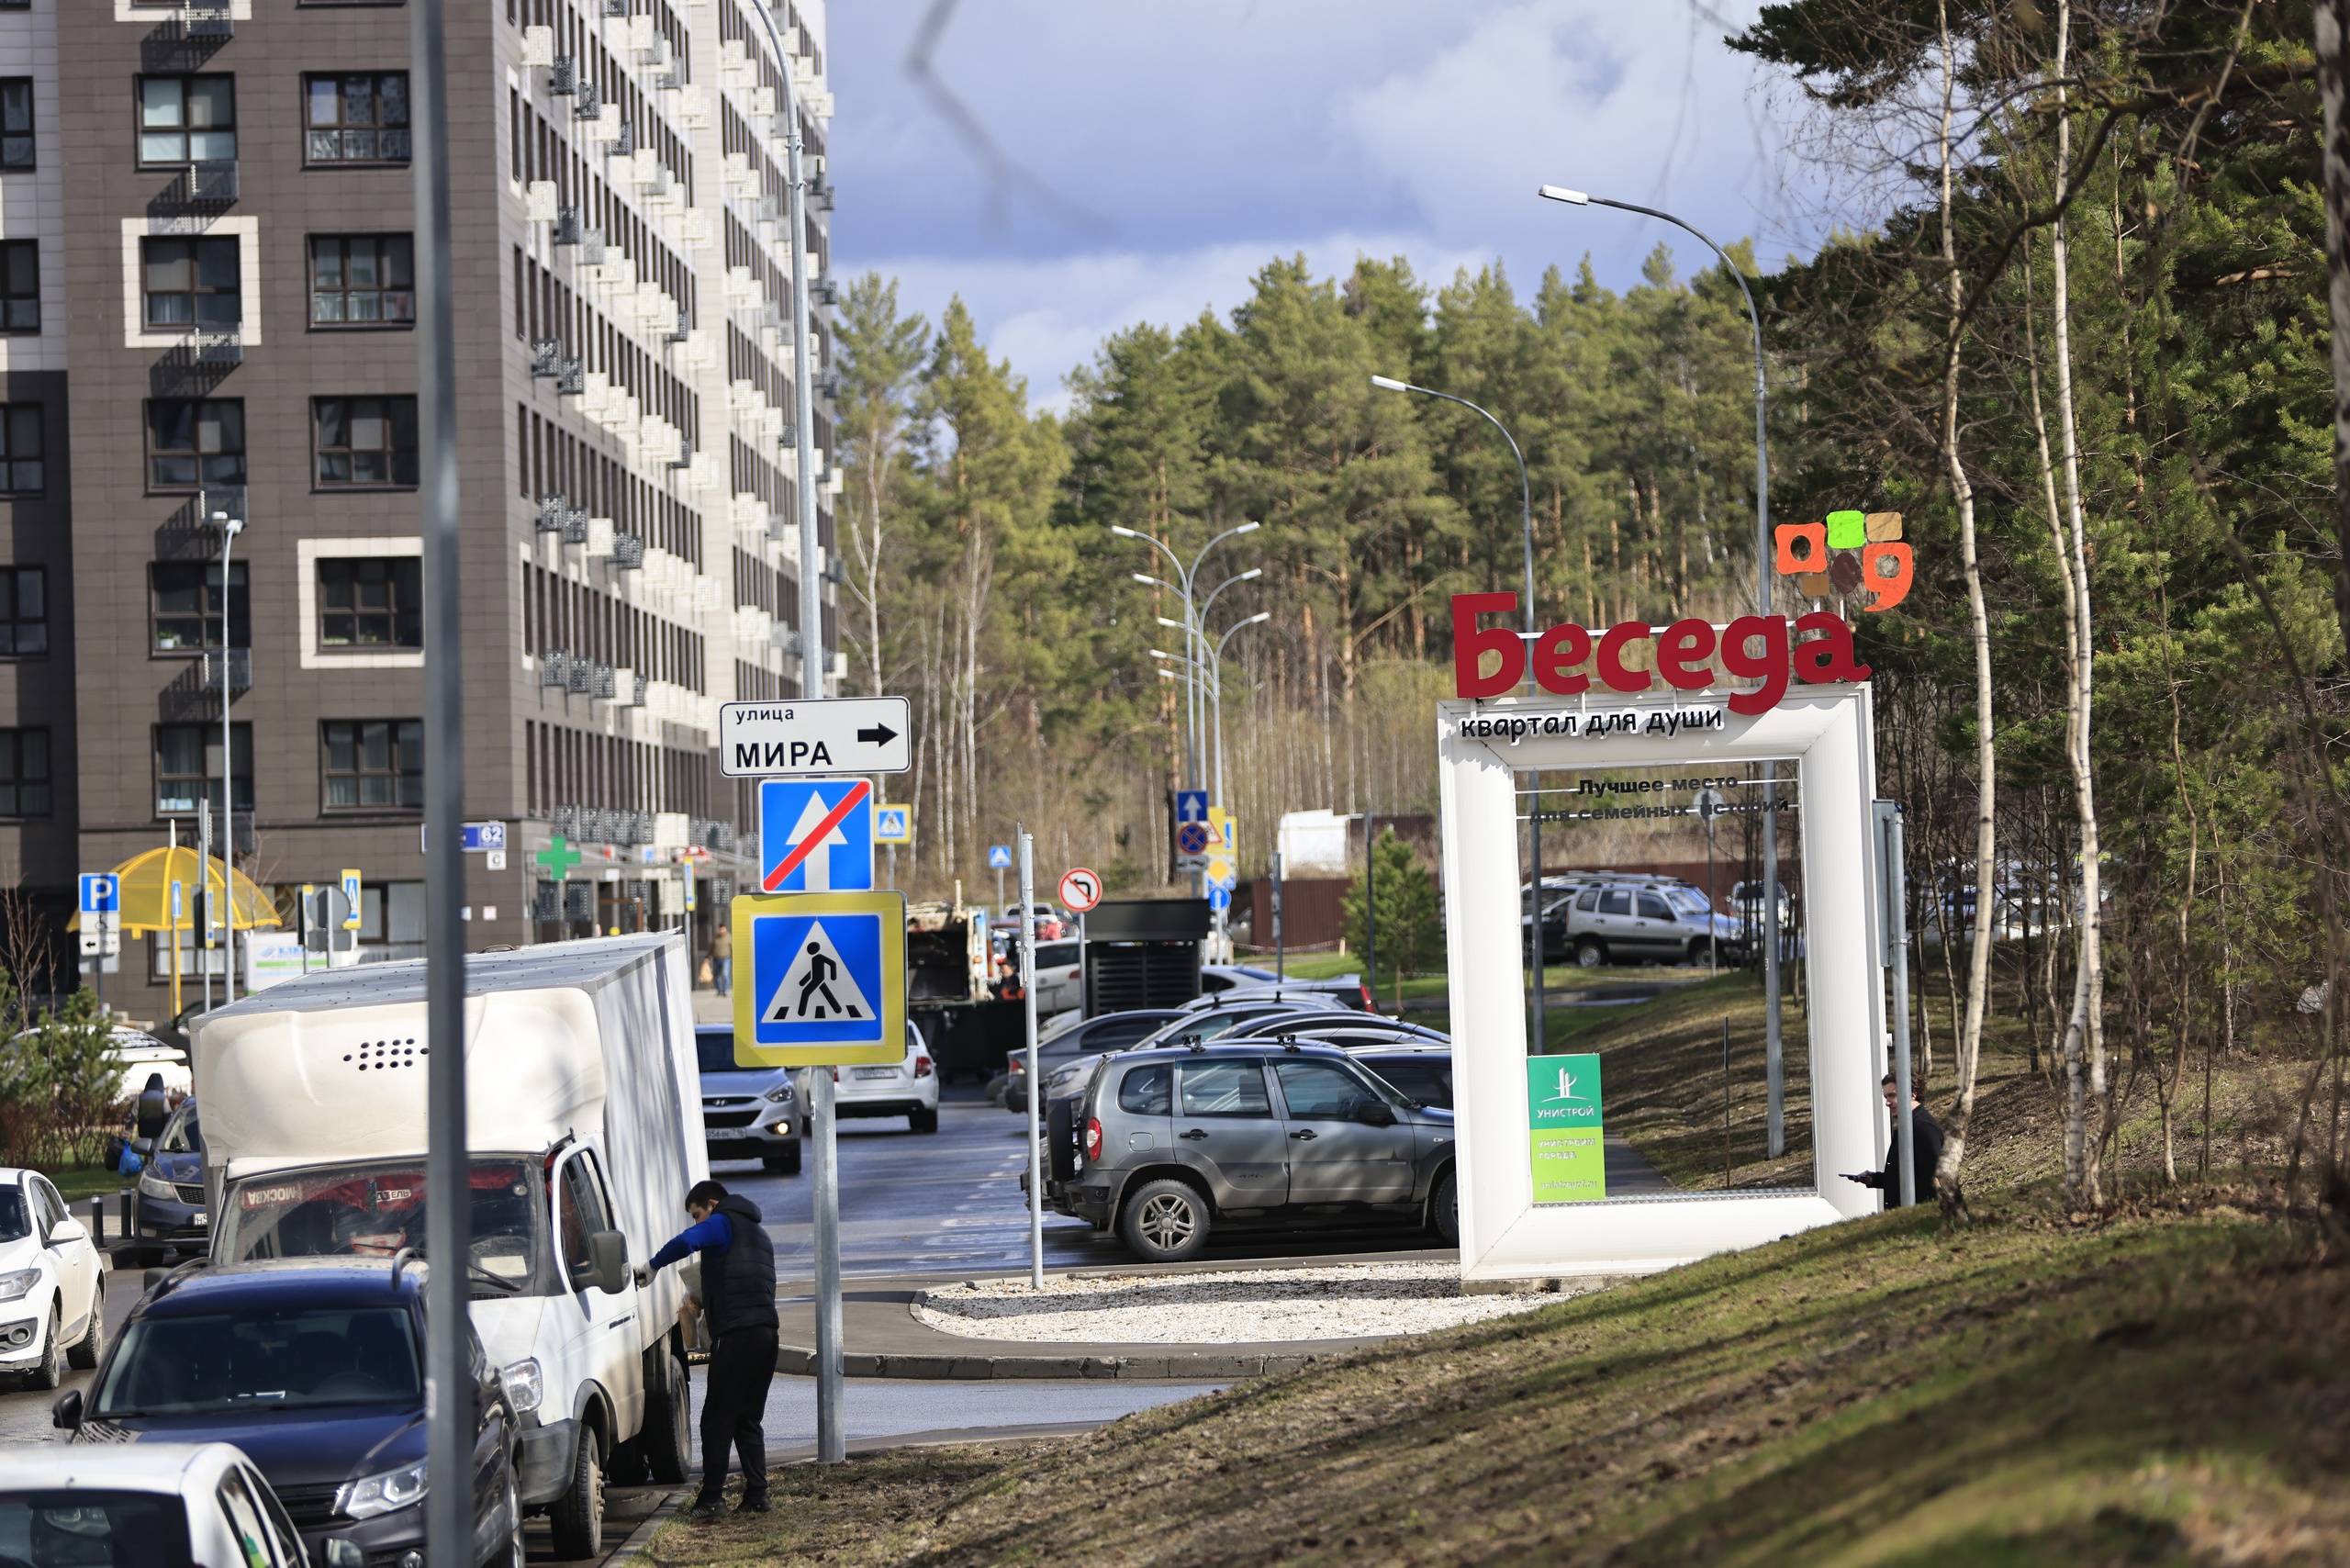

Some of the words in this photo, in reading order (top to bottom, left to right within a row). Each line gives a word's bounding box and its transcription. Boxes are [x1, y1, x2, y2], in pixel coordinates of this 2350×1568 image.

[1452, 591, 1873, 716] Беседа
[735, 708, 795, 725] улица
[1460, 714, 1577, 742] квартал
[1585, 711, 1637, 736] для
[1651, 707, 1722, 734] души
[735, 740, 834, 768] МИРА
[1578, 778, 1664, 799] Лучшее
[1672, 776, 1739, 790] место
[1529, 809, 1571, 825] для
[1577, 804, 1690, 821] семейных
[1700, 797, 1789, 815] историй
[481, 825, 502, 843] 62
[1537, 1104, 1595, 1119] УНИСТРОЙ
[248, 1186, 296, 1205] МОСКВА
